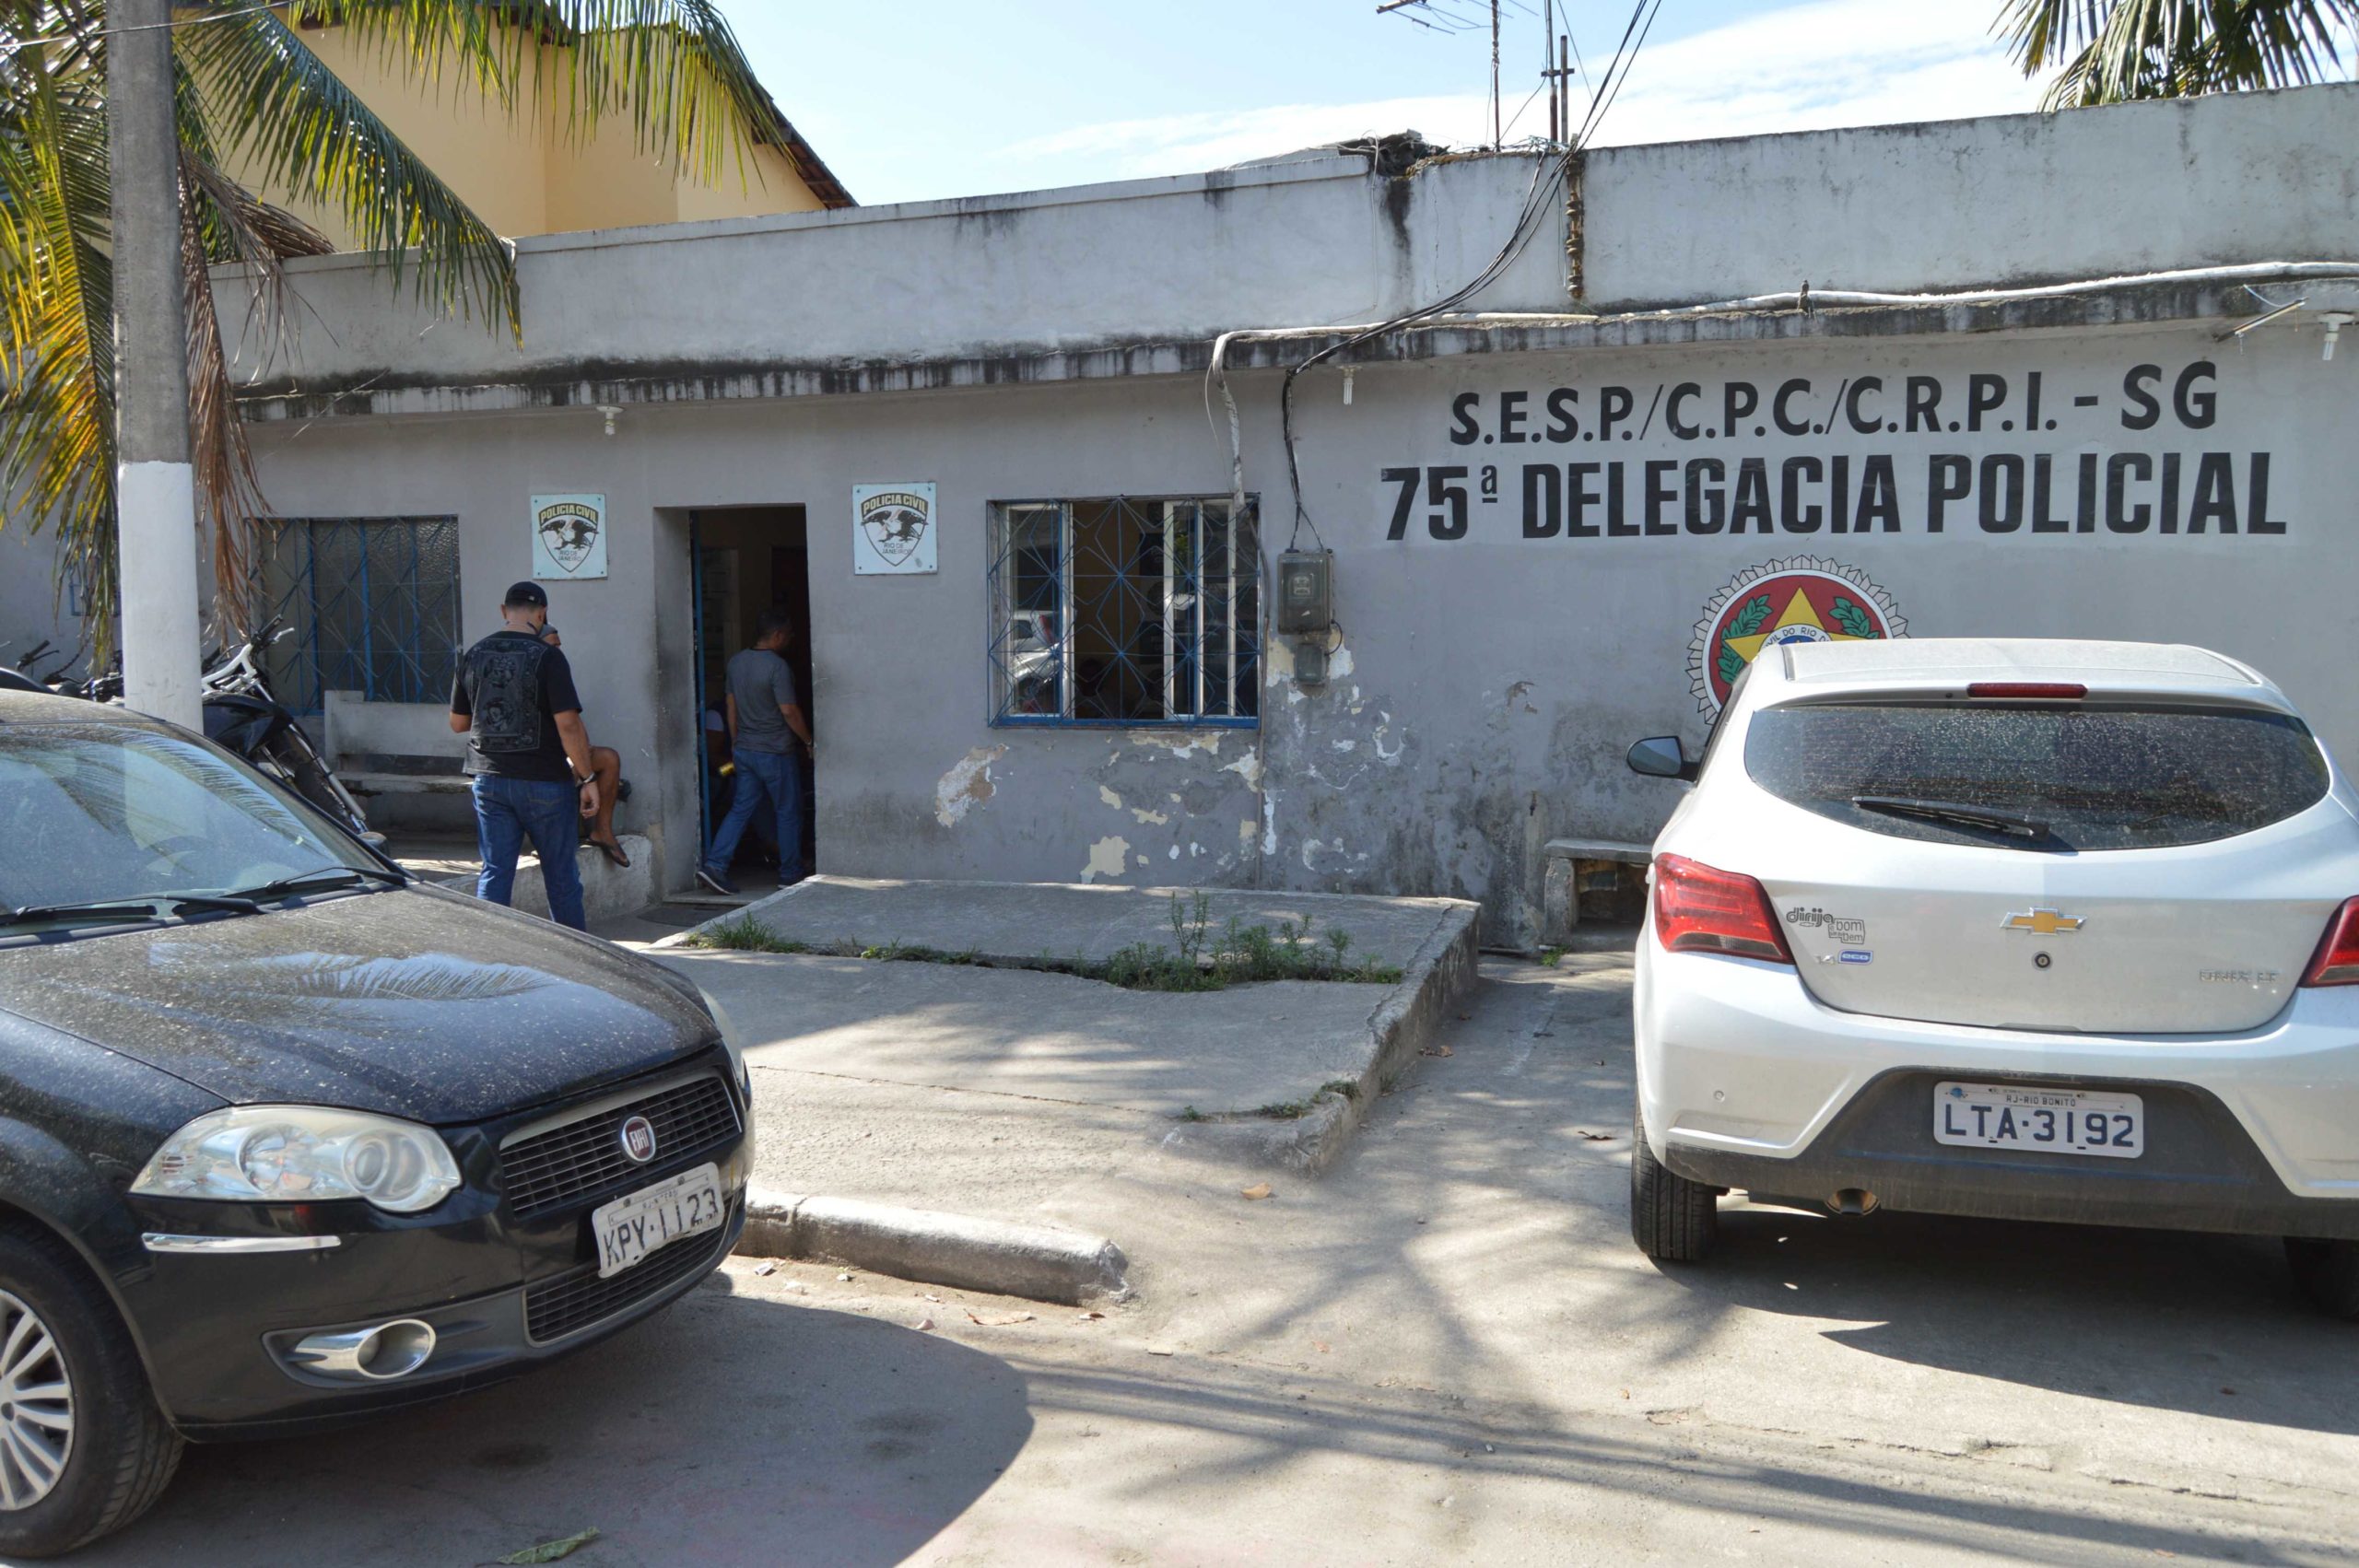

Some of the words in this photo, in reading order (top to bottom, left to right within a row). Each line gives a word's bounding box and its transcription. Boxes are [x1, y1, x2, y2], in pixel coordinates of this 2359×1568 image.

[903, 495, 927, 515] CIVIL
[1521, 454, 1902, 539] DELEGACIA
[1926, 451, 2288, 535] POLICIAL
[575, 505, 597, 524] CIVIL
[1782, 627, 1796, 638] DO
[1801, 626, 1816, 637] RIO
[1786, 907, 1835, 928] dirija
[2042, 1097, 2076, 1107] BONITO
[1945, 1104, 2134, 1147] LTA-3192
[628, 1127, 650, 1152] FIAT
[604, 1188, 719, 1268] KPY-1123
